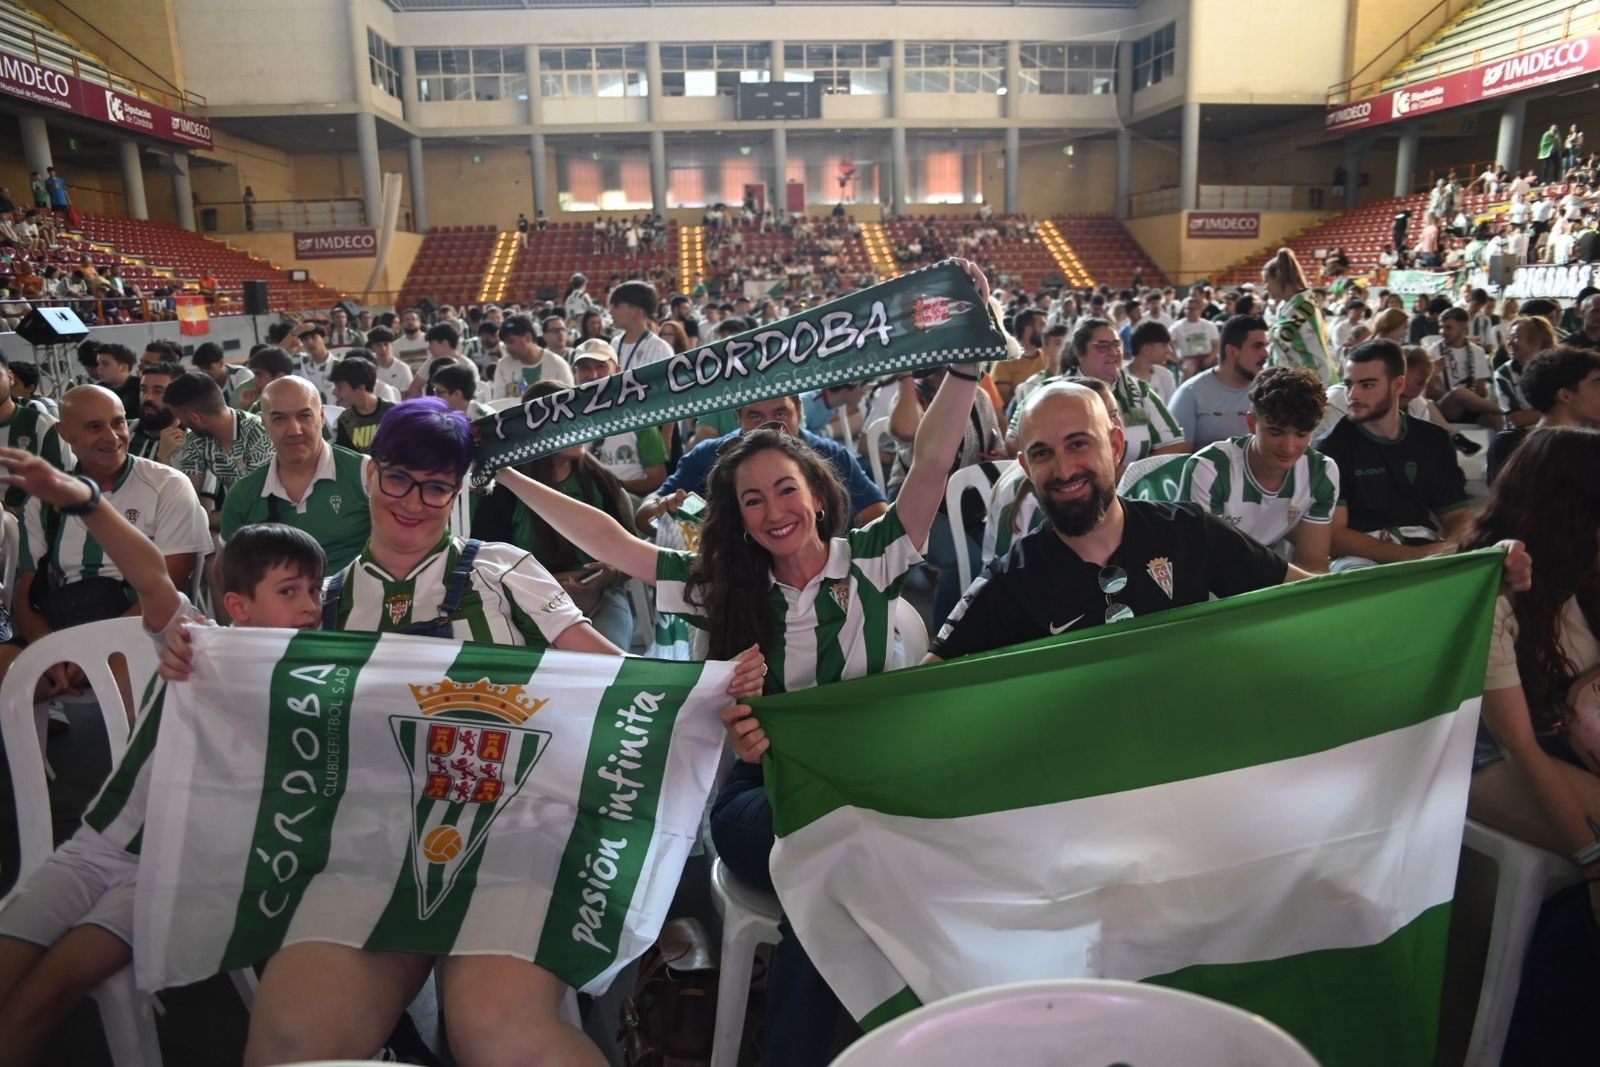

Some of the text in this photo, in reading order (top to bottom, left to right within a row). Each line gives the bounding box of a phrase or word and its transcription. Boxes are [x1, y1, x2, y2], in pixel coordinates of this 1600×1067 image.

[1504, 38, 1588, 81] IMDECO
[124, 102, 152, 119] Diputación
[1336, 102, 1371, 122] IMDECO
[181, 118, 211, 140] IMDECO
[1204, 217, 1258, 230] IMDECO
[315, 235, 375, 250] IMDECO
[667, 300, 893, 393] CORDOBA
[256, 663, 337, 919] CÓRDOBA
[572, 690, 666, 954] pasión infinita
